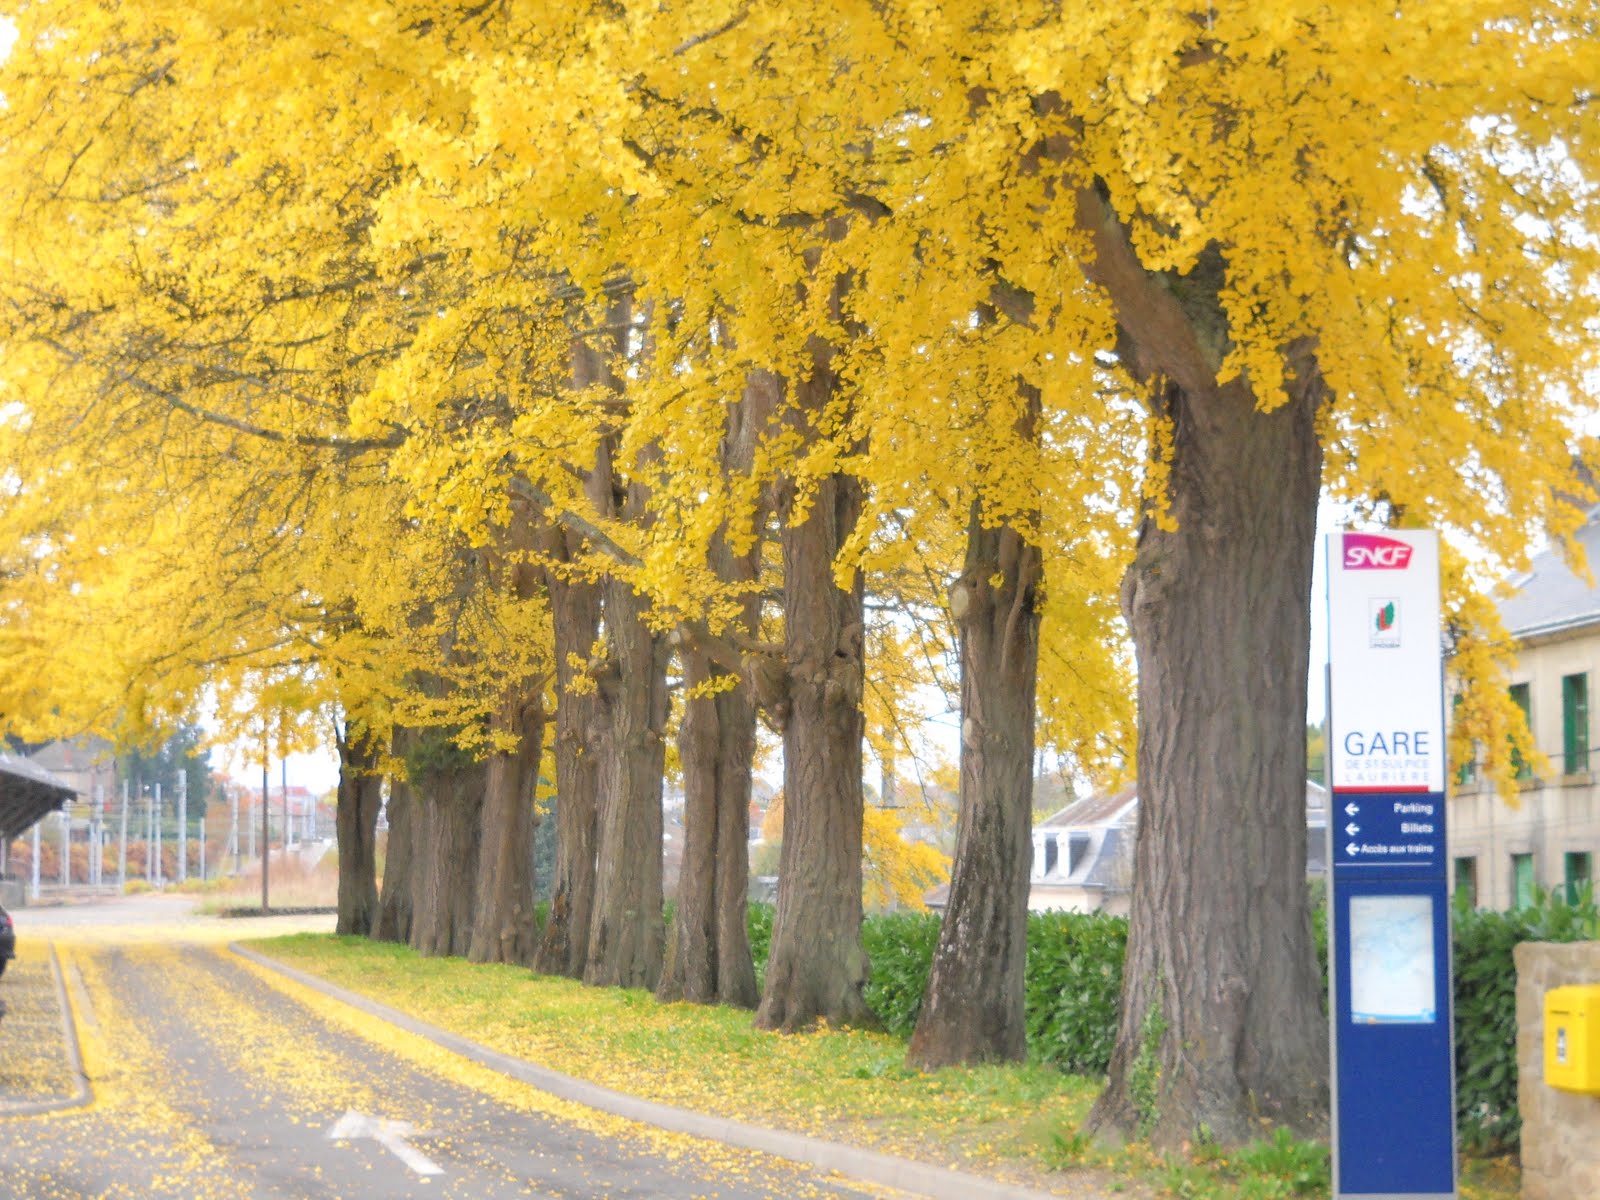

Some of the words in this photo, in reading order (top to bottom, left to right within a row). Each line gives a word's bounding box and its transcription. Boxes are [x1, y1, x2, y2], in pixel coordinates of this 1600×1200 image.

[1346, 547, 1409, 566] SNCF
[1345, 731, 1429, 756] GARE
[1345, 759, 1360, 769] DE
[1393, 802, 1434, 815] Parking
[1401, 823, 1434, 833] Billets
[1389, 845, 1407, 854] aux
[1408, 843, 1434, 854] trains
